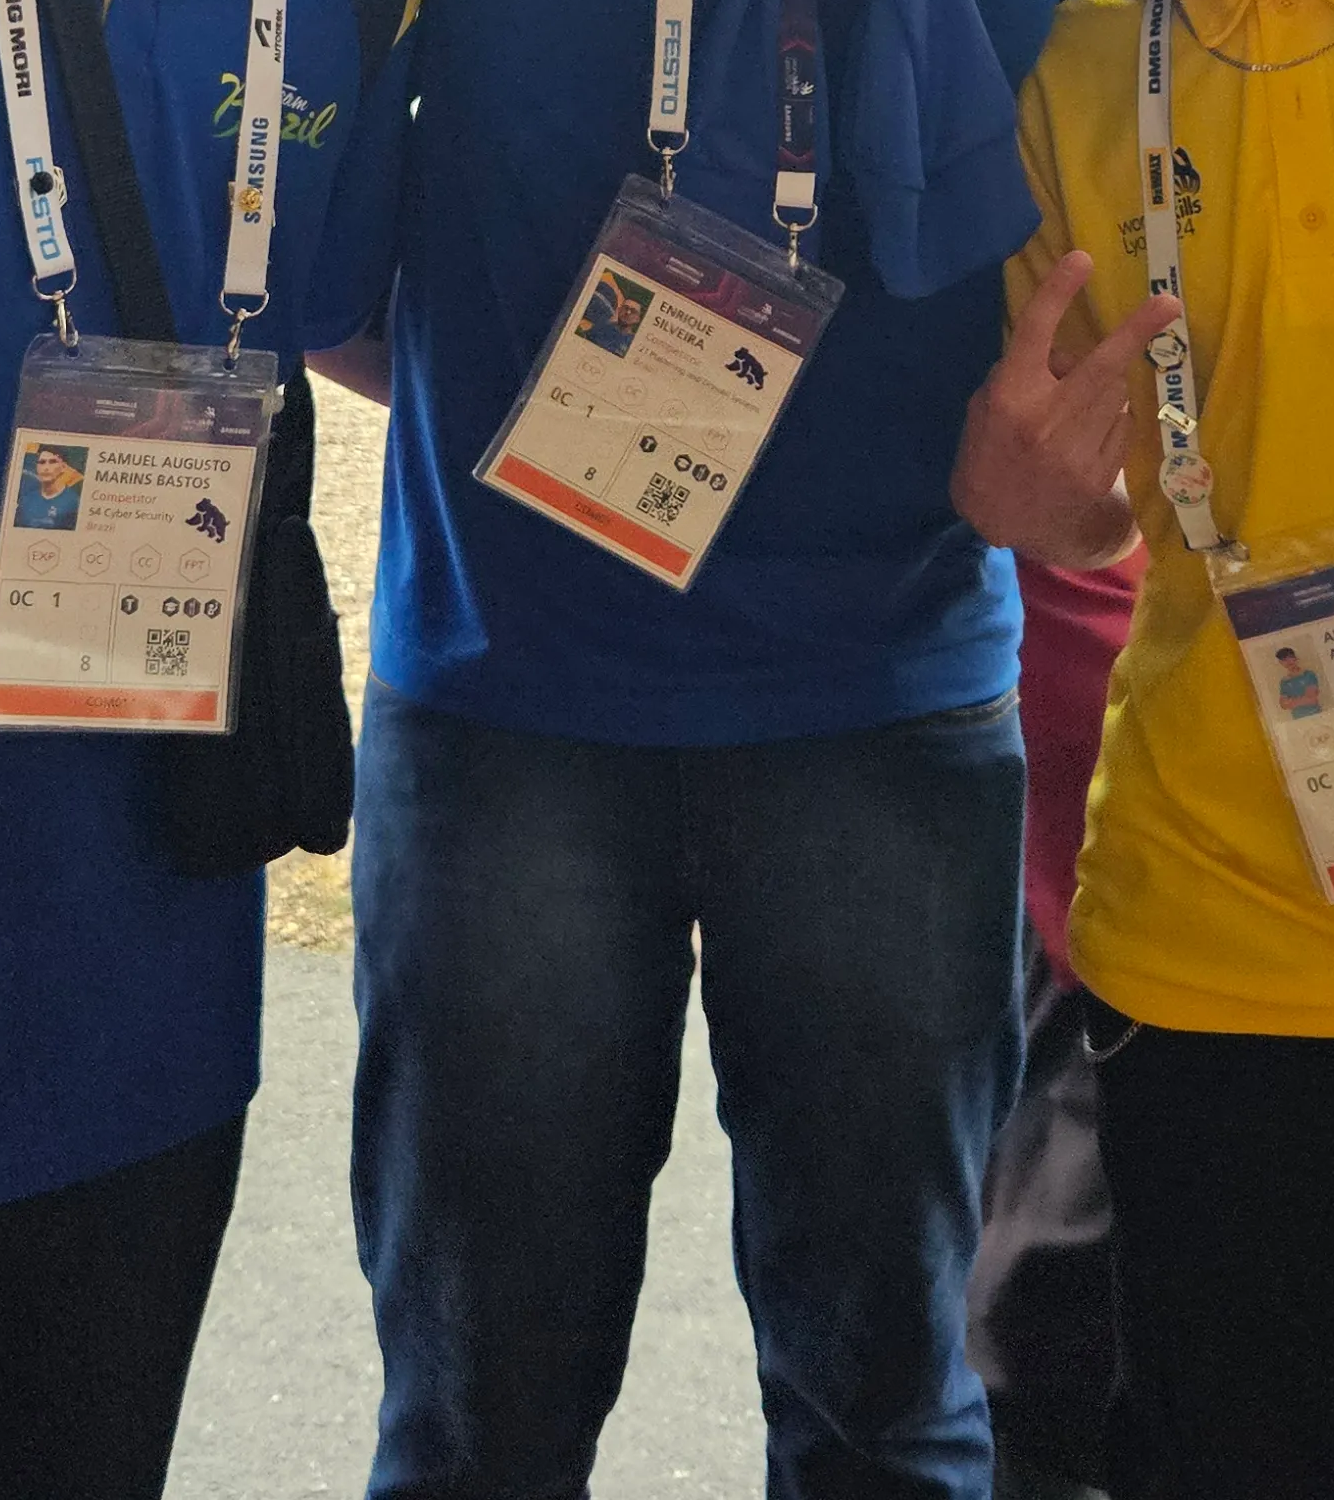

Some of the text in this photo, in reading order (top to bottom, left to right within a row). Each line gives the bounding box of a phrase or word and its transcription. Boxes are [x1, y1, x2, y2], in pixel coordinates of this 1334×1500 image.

[274, 8, 284, 63] AUTODESK
[9, 27, 33, 98] MORI
[660, 18, 682, 116] FESTO
[1148, 39, 1161, 95] DMG
[243, 116, 270, 224] SMSUNG
[659, 300, 716, 337] ENRIQUE
[653, 315, 706, 351] SILVEIRA
[586, 404, 594, 418] 1
[97, 451, 231, 472] SAMUEL AUGUSTO
[95, 470, 211, 490] MARINS BASTOS
[584, 467, 597, 481] 8
[91, 489, 158, 506] Competitor
[103, 507, 133, 520] Cyber
[135, 510, 175, 524] Security
[85, 553, 104, 565] OC
[137, 556, 153, 568] CC
[52, 591, 60, 607] 1
[80, 655, 91, 671] 8
